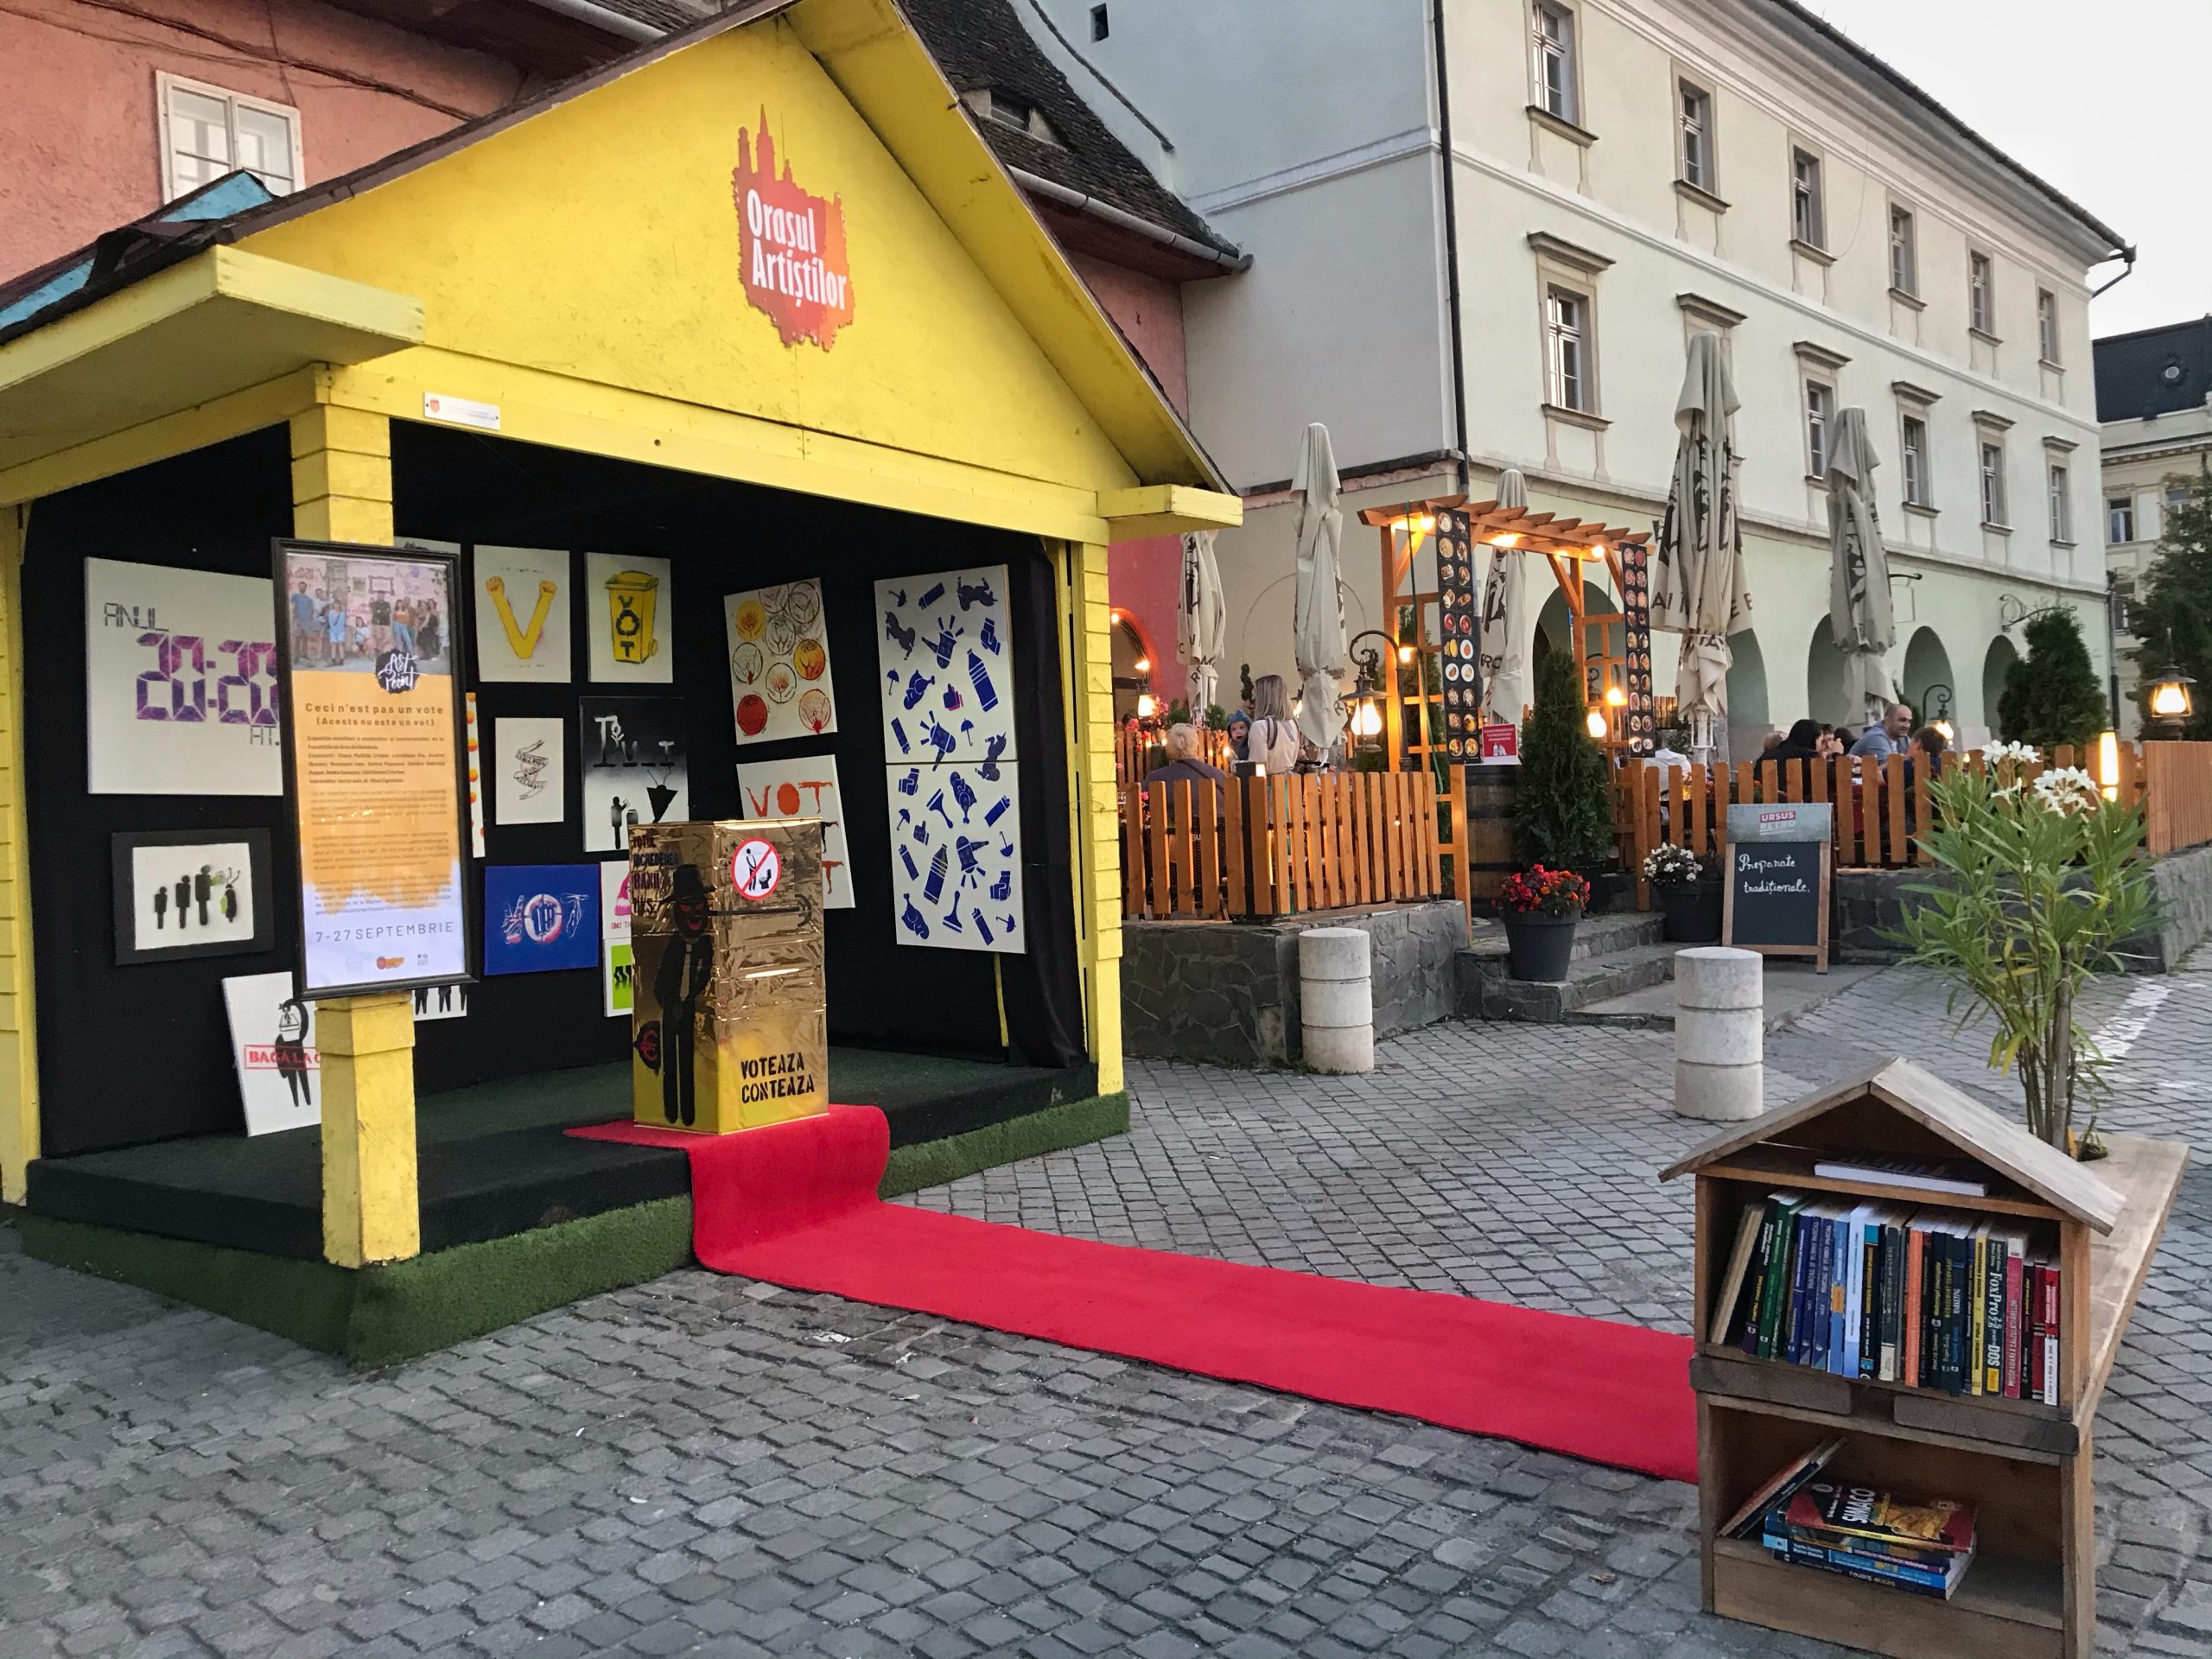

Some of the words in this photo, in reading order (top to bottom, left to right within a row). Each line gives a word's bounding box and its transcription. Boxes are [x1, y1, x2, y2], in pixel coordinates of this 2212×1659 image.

[305, 702, 334, 713] Ceci
[373, 706, 395, 715] pas
[416, 706, 443, 715] vote
[1761, 811, 1796, 822] URSUS
[1738, 854, 1796, 874] Preparate
[315, 930, 352, 943] 7-27
[355, 921, 454, 940] SEPTEMBRIE
[741, 1052, 804, 1080] VOTEAZA
[741, 1074, 815, 1104] CONTEAZA
[1988, 1272, 2003, 1318] FoxPro
[1987, 1344, 2000, 1367] DOS
